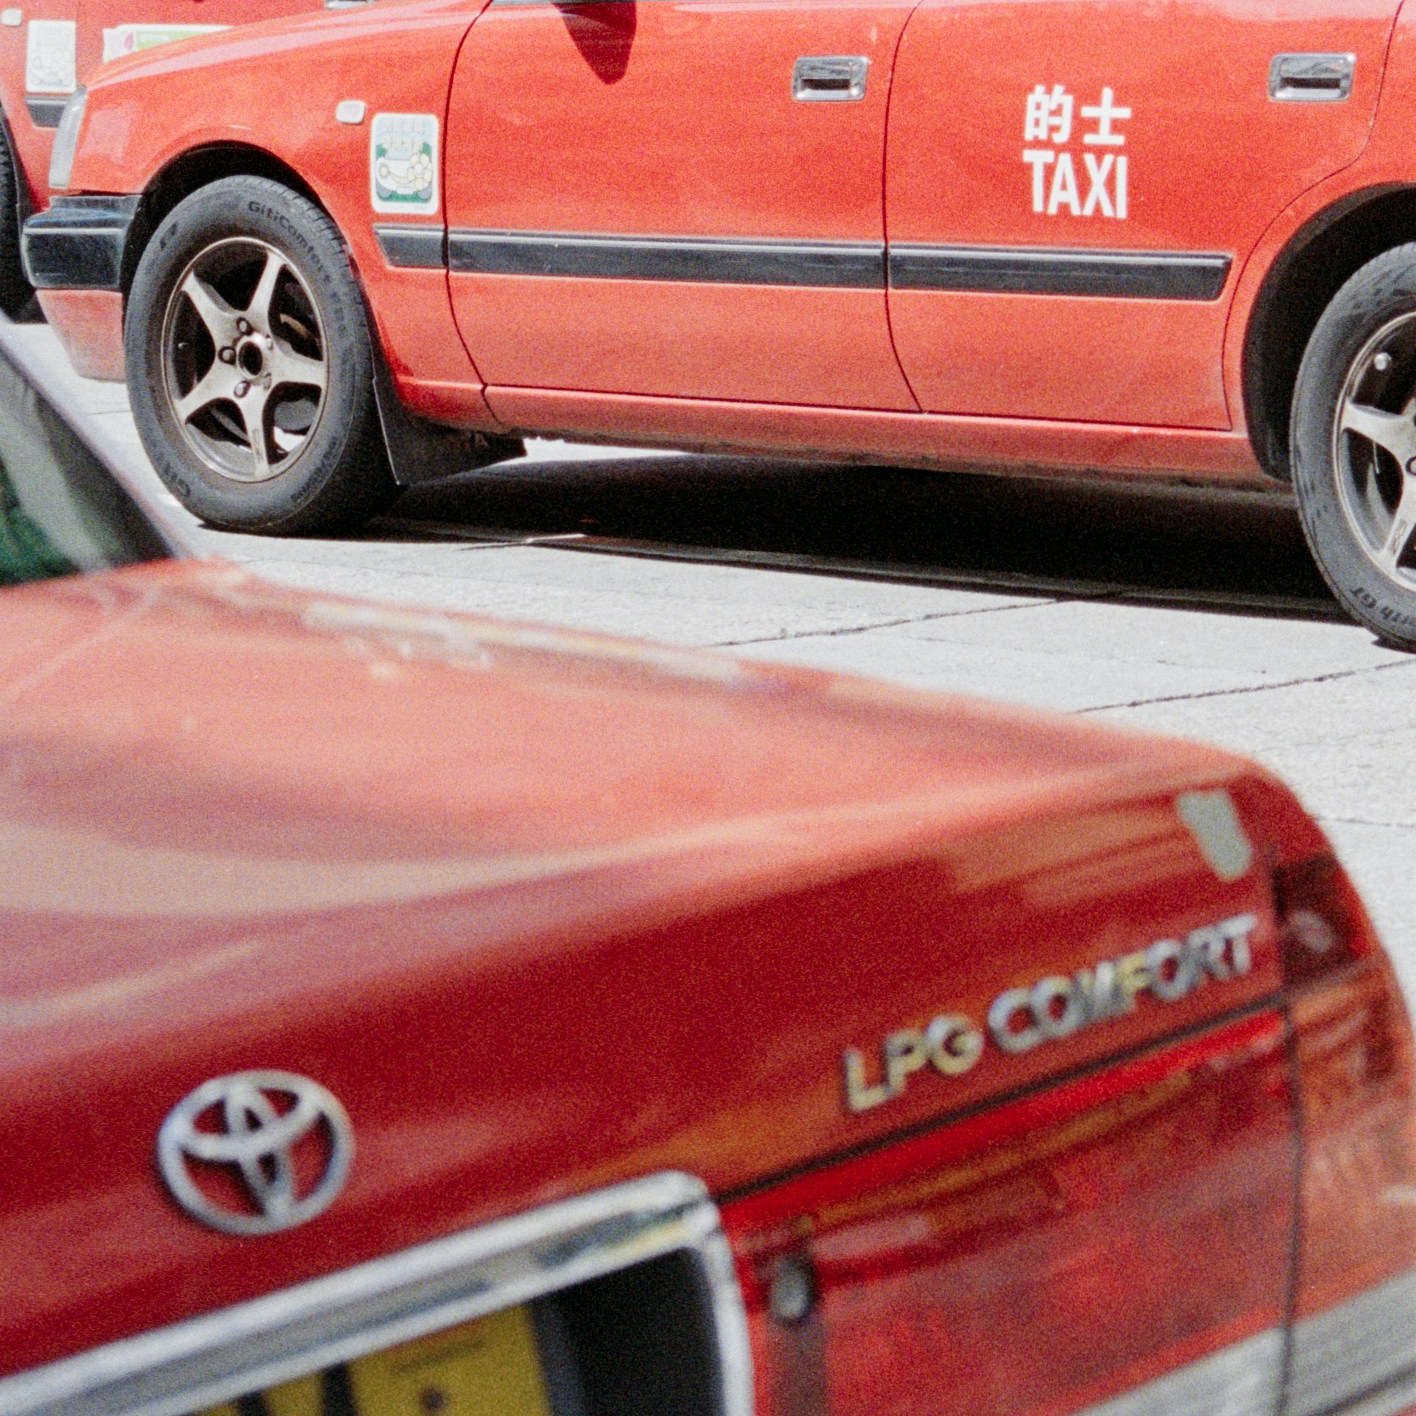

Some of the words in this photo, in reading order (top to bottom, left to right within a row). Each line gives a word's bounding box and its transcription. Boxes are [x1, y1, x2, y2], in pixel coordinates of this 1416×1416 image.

[1023, 83, 1133, 146] 的士
[1021, 148, 1129, 220] TAXI
[843, 1012, 985, 1112] LPG
[988, 912, 1259, 1054] COMFORT
